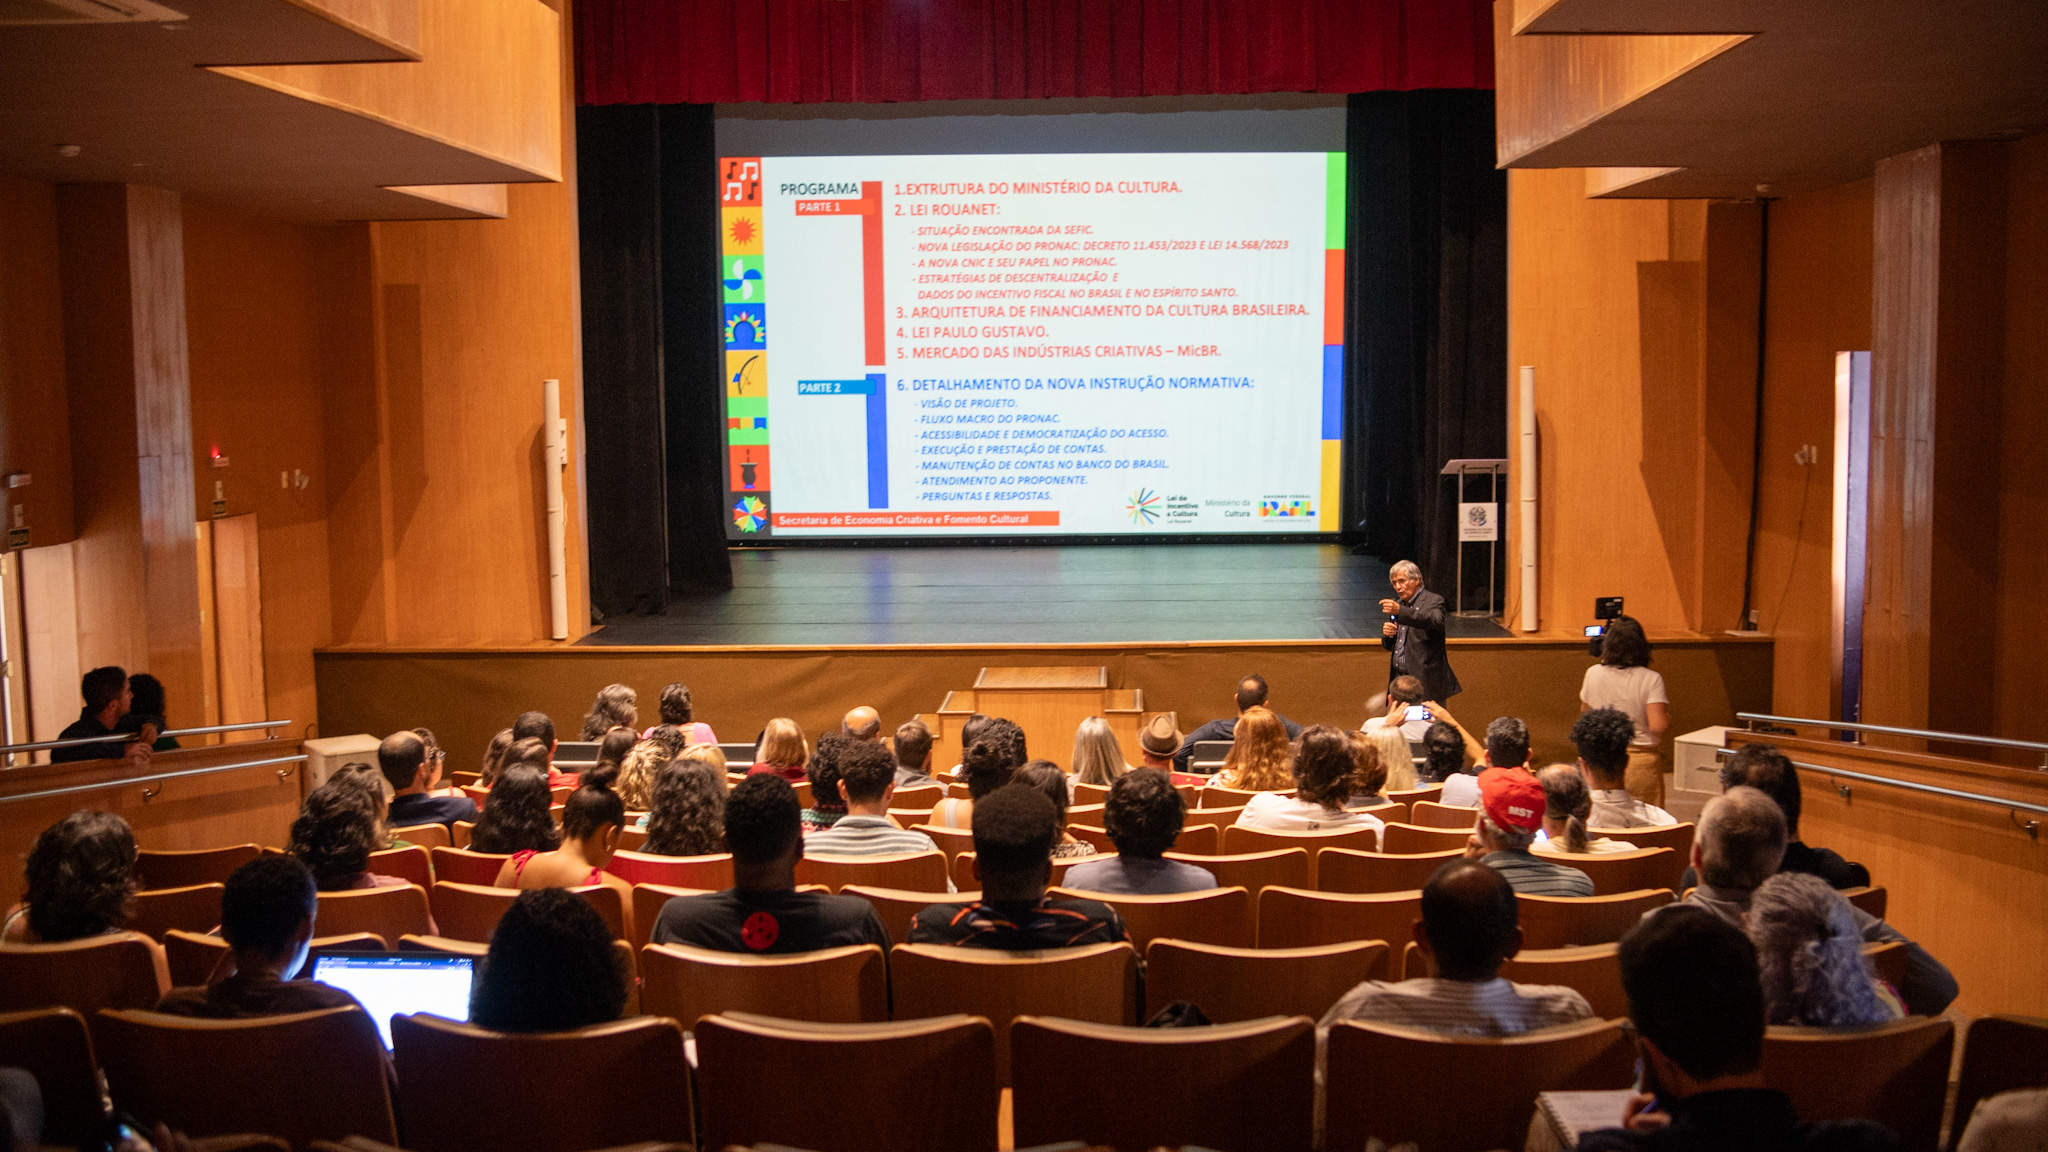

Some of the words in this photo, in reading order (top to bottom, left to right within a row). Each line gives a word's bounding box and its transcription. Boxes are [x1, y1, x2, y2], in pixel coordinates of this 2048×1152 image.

[780, 182, 859, 195] PROGRAMA
[895, 182, 985, 196] 1.EXTRUTURA
[989, 182, 1009, 195] DO
[1013, 179, 1091, 194] MINISTÉRIO
[1095, 181, 1114, 193] DA
[1118, 181, 1182, 194] CULTURA.
[799, 202, 832, 212] PARTE
[834, 202, 840, 212] 1
[895, 204, 906, 216] 2.
[910, 204, 928, 216] LEI
[932, 203, 1000, 216] ROUANET:
[918, 224, 970, 238] SITUAÇÃO
[972, 225, 1044, 236] ENCONTRADA
[1046, 225, 1062, 235] DA
[1064, 225, 1093, 235] SEFIC.
[918, 242, 948, 252] NOVA
[951, 240, 1013, 253] LEGISLAÇÃO
[1016, 241, 1032, 251] DO
[1034, 241, 1080, 251] PRONAC:
[1083, 241, 1130, 251] DECRETO
[1133, 240, 1197, 251] 11.453/2023
[1199, 240, 1206, 250] E
[1208, 240, 1223, 250] LEI
[1225, 240, 1289, 250] 14.568/2023
[918, 259, 926, 268] A
[928, 258, 958, 268] NOVA
[961, 258, 986, 268] CNIC
[988, 258, 994, 268] E
[996, 258, 1016, 267] SEU
[1018, 257, 1050, 267] PAPEL
[1053, 257, 1069, 267] NO
[1072, 257, 1116, 266] PRONAC.
[918, 272, 986, 284] ESTRATÉGIAS
[988, 273, 1002, 283] DE
[1004, 270, 1108, 284] DESCENTRALIZAÇÃO
[1113, 273, 1119, 282] E
[918, 290, 954, 300] DADOS
[956, 290, 973, 299] DO
[975, 289, 1031, 299] INCENTIVO
[1033, 289, 1066, 298] FISCAL
[1069, 289, 1086, 298] NO
[1088, 288, 1122, 298] BRASIL
[1125, 288, 1131, 298] E
[1134, 288, 1151, 298] NO
[1152, 287, 1198, 298] ESPÍRITO
[1200, 288, 1238, 297] SANTO.
[897, 306, 907, 319] 3.
[912, 306, 1005, 320] ARQUITETURA
[1009, 306, 1025, 317] DE
[1030, 304, 1142, 317] FINANCIAMENTO
[1146, 305, 1164, 316] DA
[1168, 304, 1228, 317] CULTURA
[1232, 304, 1309, 316] BRASILEIRA.
[896, 327, 908, 338] 4.
[912, 326, 929, 338] LEI
[934, 326, 978, 338] PAULO
[982, 325, 1049, 338] GUSTAVO.
[897, 347, 908, 359] 5.
[913, 346, 979, 359] MERCADO
[983, 346, 1009, 358] DAS
[1013, 344, 1091, 358] INDÚSTRIAS
[1095, 345, 1162, 358] CRIATIVAS
[1178, 345, 1221, 357] MicBR.
[800, 383, 832, 393] PARTE
[834, 382, 841, 392] 2
[897, 379, 908, 391] 6.
[913, 378, 1021, 391] DETALHAMENTO
[1025, 378, 1043, 390] DA
[1048, 378, 1086, 390] NOVA
[1090, 375, 1165, 392] INSTRUÇÃO
[1169, 377, 1254, 389] NORMATIVA:
[921, 397, 952, 408] VISÃO
[954, 399, 968, 408] DE
[970, 398, 1018, 408] PROJETO.
[921, 415, 954, 424] FLUXO
[956, 414, 995, 424] MACRO
[997, 414, 1013, 424] DO
[1016, 414, 1060, 423] PRONAC.
[920, 430, 1001, 440] ACESSIBILIDADE
[1003, 430, 1009, 439] E
[1012, 427, 1108, 440] DEMOCRATIZAÇÃO
[1110, 429, 1126, 438] DO
[1127, 429, 1168, 438] ACESSO.
[921, 443, 975, 456] EXECUÇÃO
[977, 445, 983, 454] E
[986, 443, 1045, 456] PRESTAÇÃO
[1047, 444, 1061, 454] DE
[1063, 444, 1106, 454] CONTAS.
[922, 458, 996, 472] MANUTENÇÃO
[998, 460, 1012, 470] DE
[1014, 460, 1055, 470] CONTAS
[1057, 460, 1074, 469] NO
[1076, 460, 1112, 469] BANCO
[1114, 460, 1130, 469] DO
[1132, 459, 1169, 469] BRASIL.
[921, 476, 997, 486] ATENDIMENTO
[999, 476, 1015, 485] AO
[1017, 475, 1088, 485] PROPONENTE.
[922, 492, 982, 501] PERGUNTAS
[985, 492, 991, 501] E
[993, 491, 1052, 500] RESPOSTAS.
[1258, 500, 1316, 516] BRASIL
[779, 516, 828, 525] Secretaria
[830, 516, 842, 525] de
[844, 515, 894, 525] Economia
[896, 515, 934, 524] Criativa
[944, 514, 988, 524] Fomento
[989, 514, 1029, 524] Cultural
[1508, 806, 1534, 818] MST
